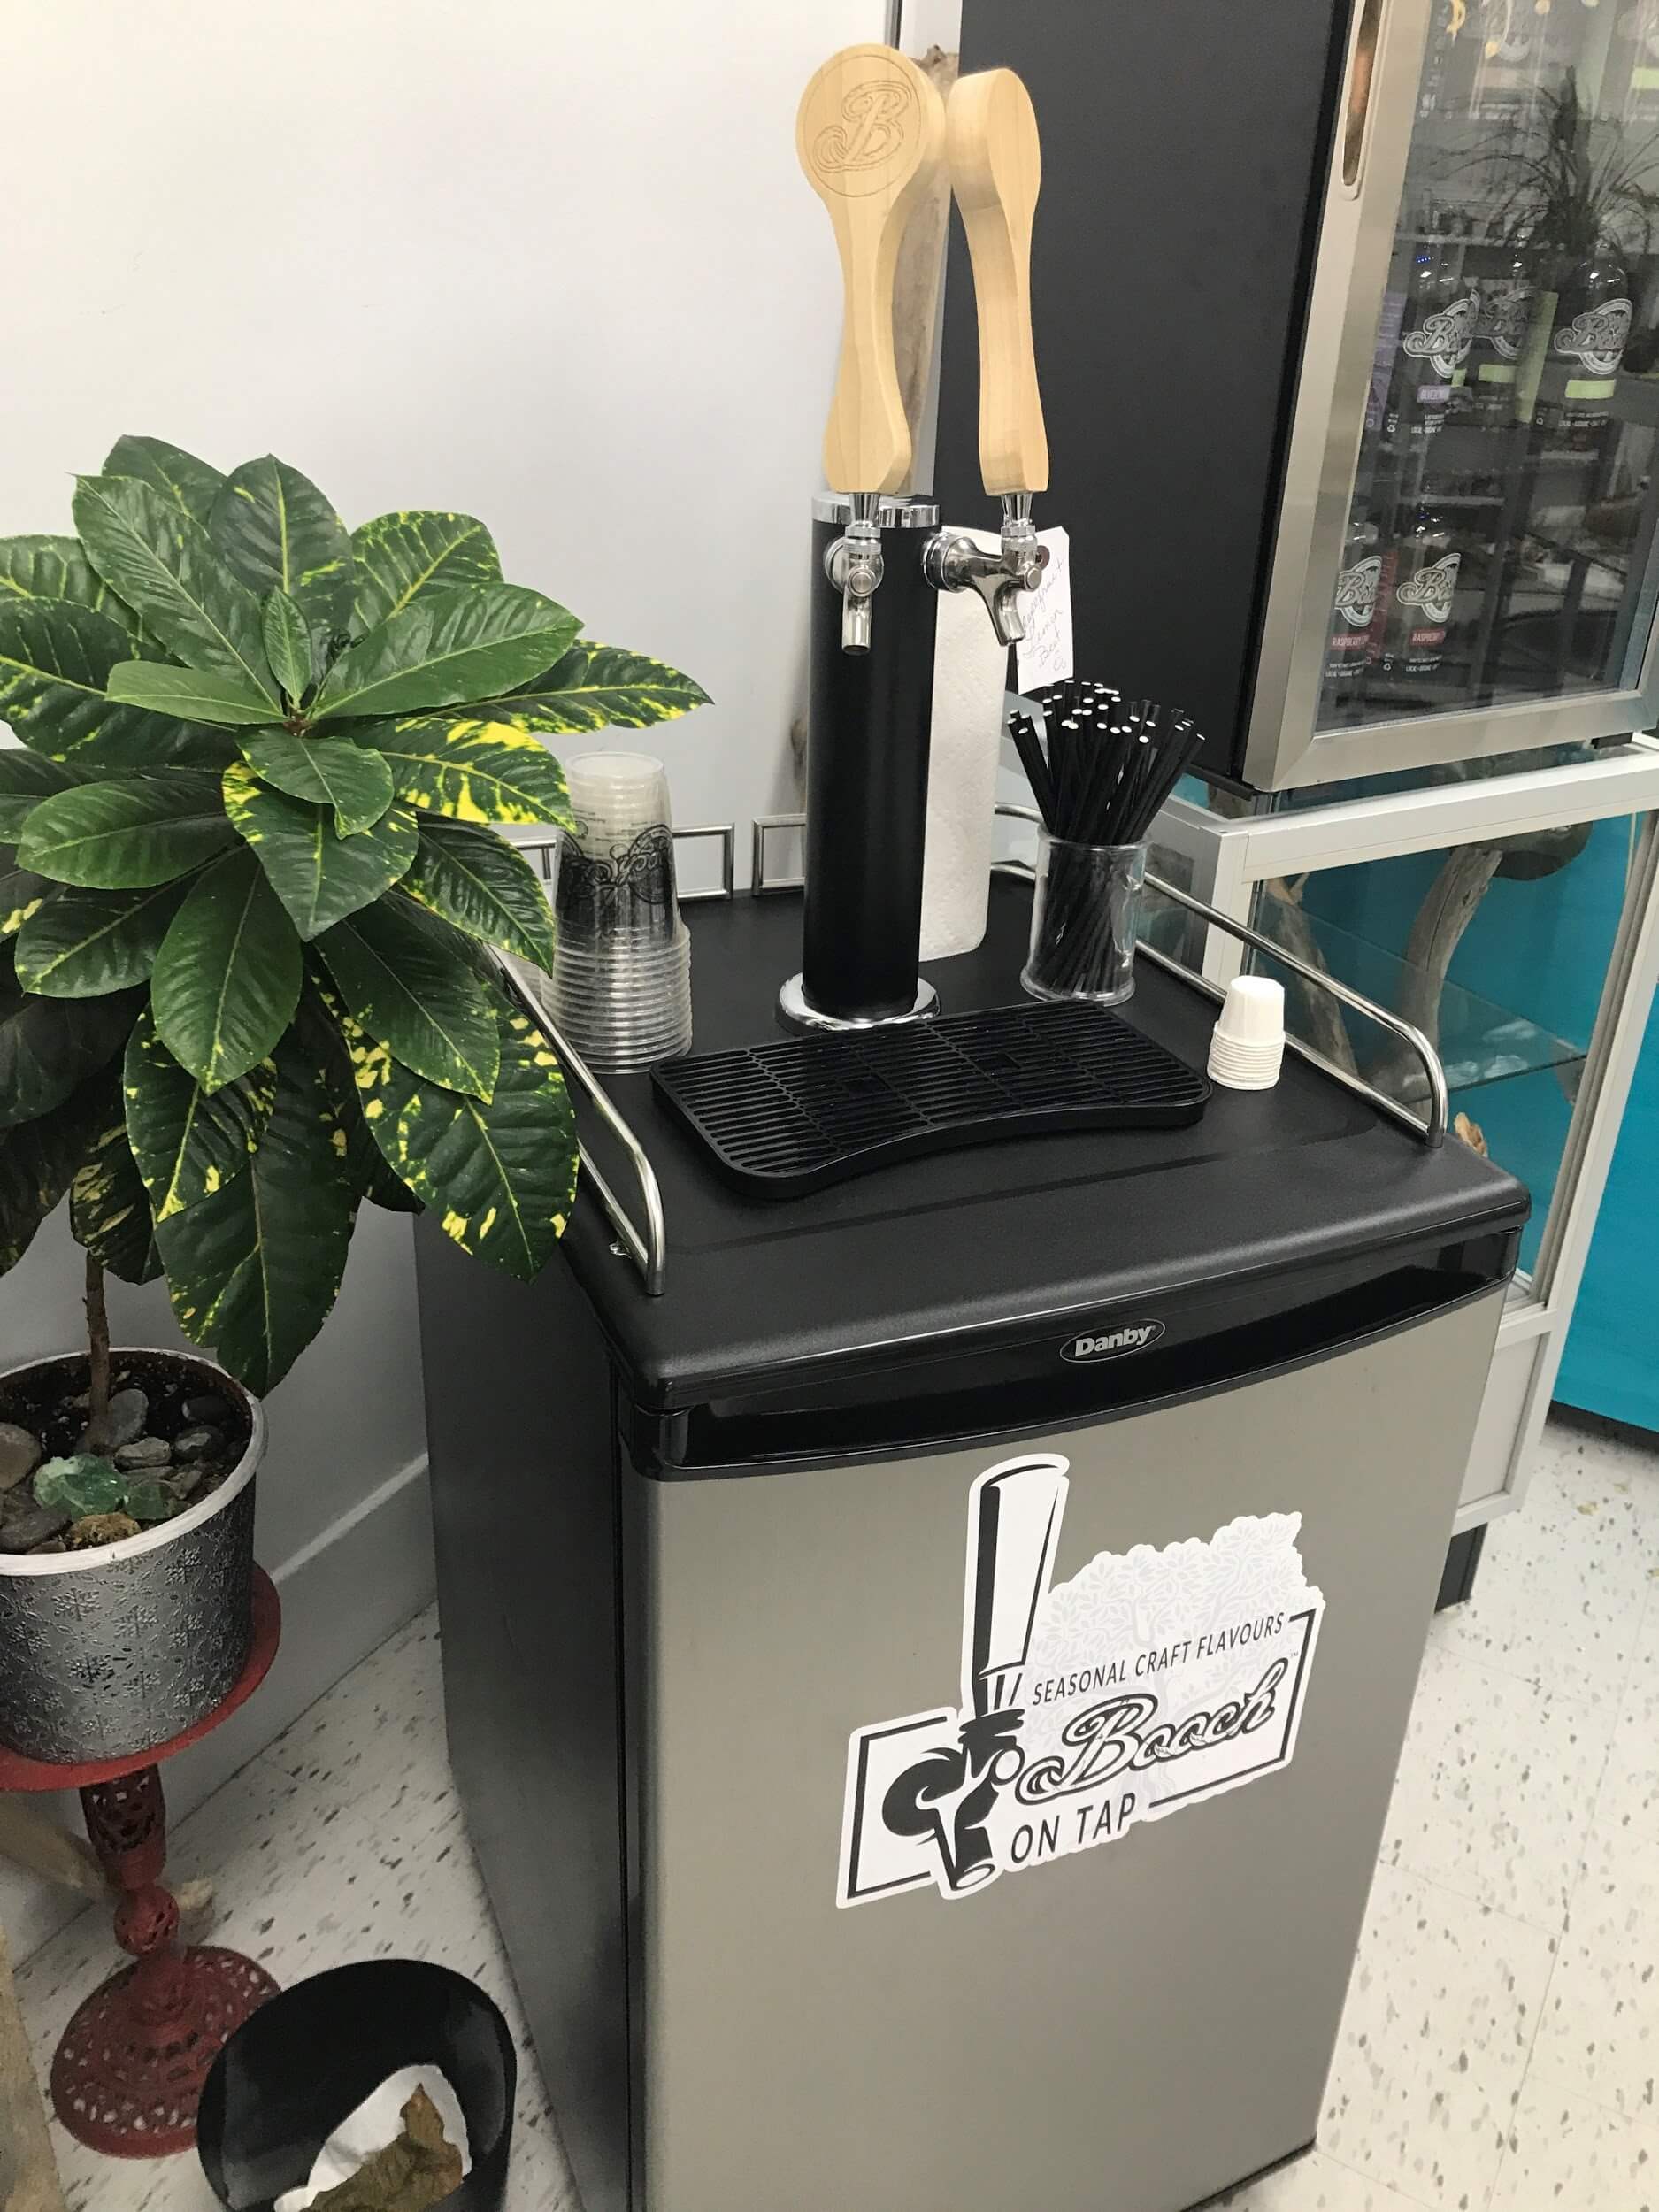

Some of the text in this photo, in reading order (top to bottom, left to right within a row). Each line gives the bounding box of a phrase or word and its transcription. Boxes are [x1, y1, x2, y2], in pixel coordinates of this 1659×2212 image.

[1074, 1325, 1153, 1356] Danby
[1033, 1612, 1285, 1706] SEASONAL CRAFT FLAVOURS
[1014, 1656, 1289, 1806] Booch
[1010, 1793, 1136, 1865] ON TAP
